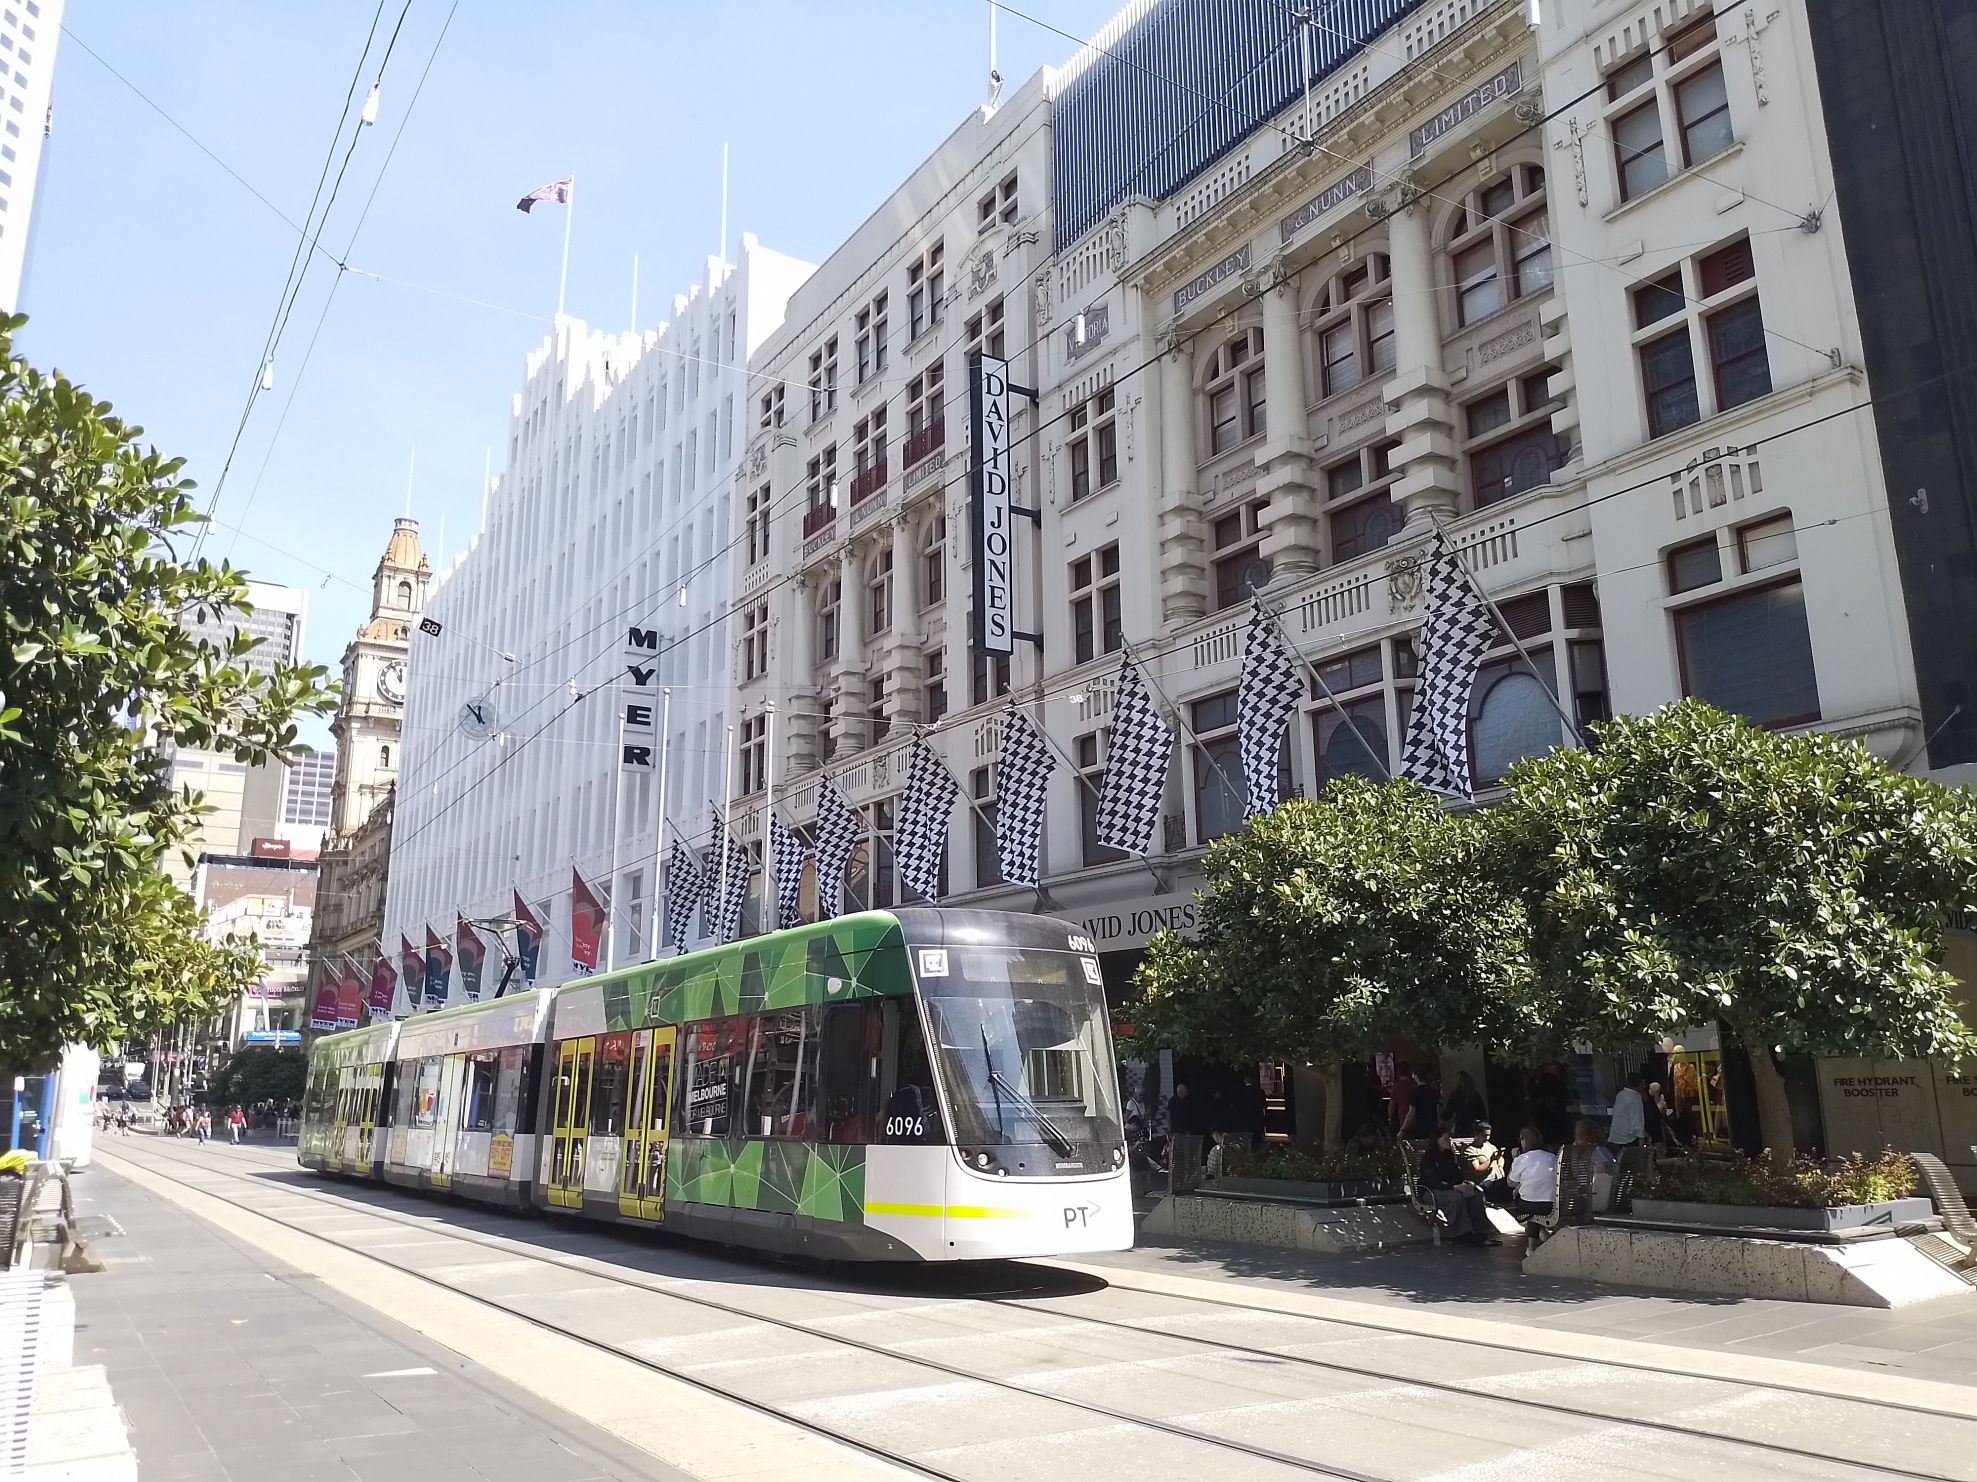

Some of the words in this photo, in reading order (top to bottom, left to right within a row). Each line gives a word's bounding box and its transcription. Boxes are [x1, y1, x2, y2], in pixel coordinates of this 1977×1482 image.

[1177, 252, 1247, 307] BUCKLEY
[1309, 175, 1358, 223] NUNN
[1421, 74, 1508, 143] LIMITED
[1068, 317, 1108, 352] VIORIA
[984, 371, 1006, 496] DAVID
[803, 527, 836, 558] BUCKLEY
[861, 496, 883, 517] NUNN
[908, 455, 941, 487] LIMITED
[987, 506, 1007, 638] JONES
[422, 621, 439, 635] 38
[623, 627, 658, 766] MYER
[1071, 915, 1122, 940] VID
[1128, 904, 1195, 936] JONES
[1067, 935, 1095, 953] 6096
[1834, 1078, 1855, 1087] FIRE
[1857, 1076, 1916, 1086] HYDRANT
[1844, 1088, 1899, 1098] BOOSTER
[885, 1116, 923, 1136] 6096
